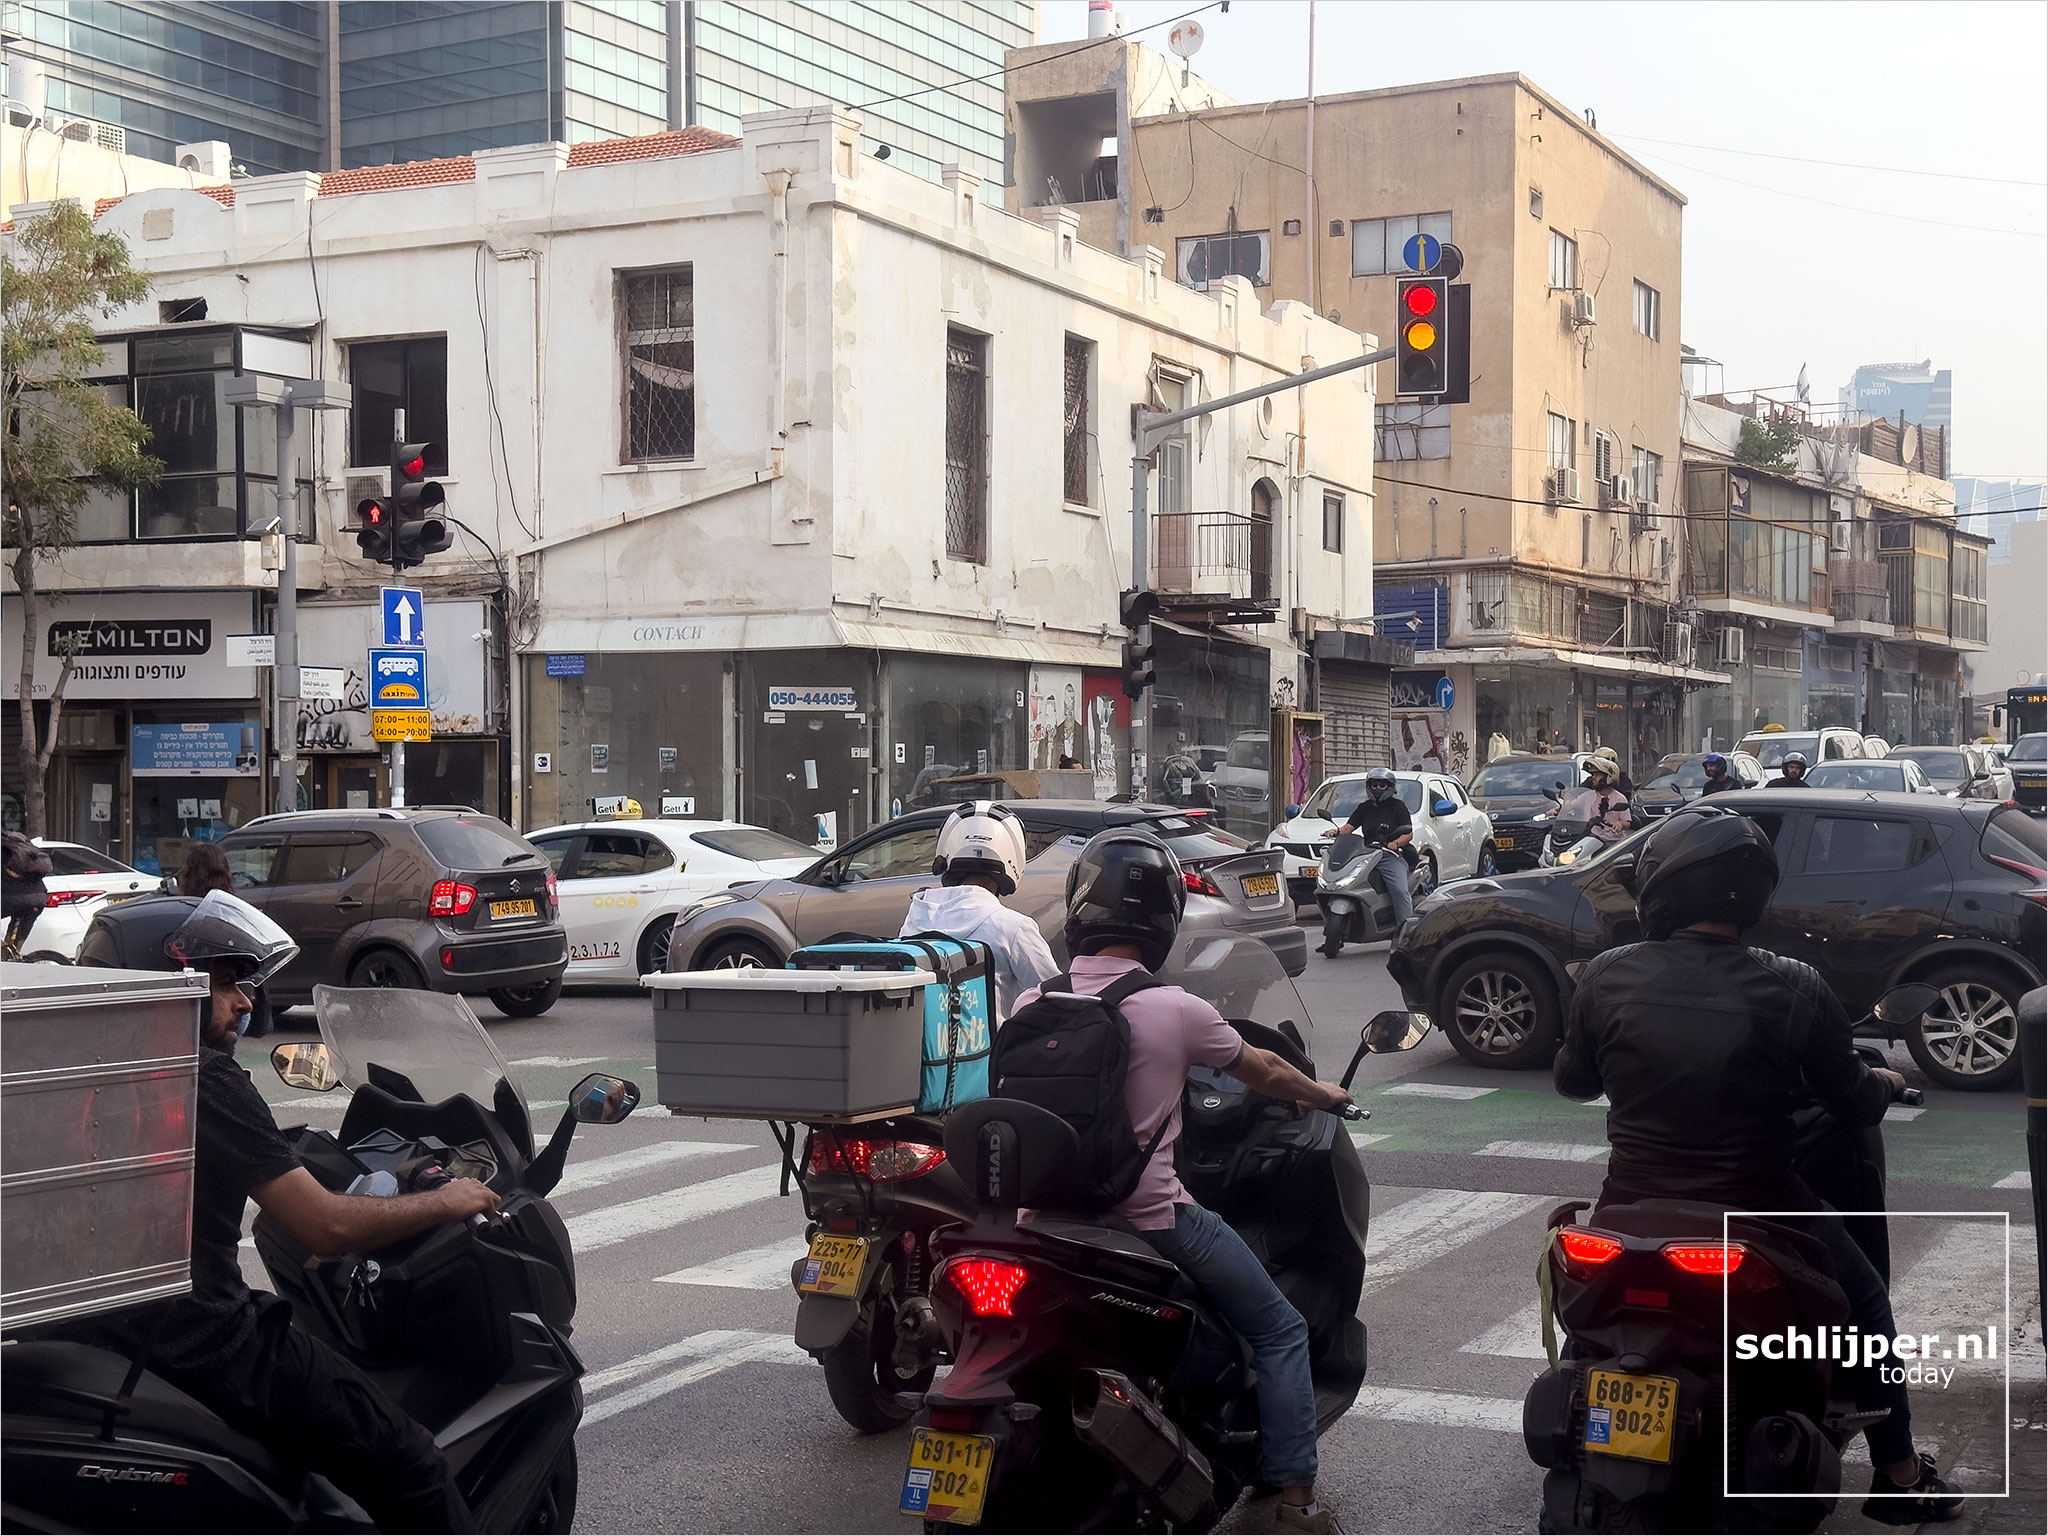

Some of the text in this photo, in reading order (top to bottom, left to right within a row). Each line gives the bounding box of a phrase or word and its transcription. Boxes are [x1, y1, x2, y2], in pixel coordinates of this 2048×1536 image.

[73, 665, 186, 681] עודפים ותצוגות
[598, 805, 615, 814] Gett
[663, 805, 681, 813] Gett
[989, 1134, 1000, 1197] SHAD
[814, 1241, 863, 1260] 225-77
[823, 1261, 846, 1279] 904
[1596, 1379, 1670, 1410] 688-75
[1615, 1409, 1653, 1436] 902
[921, 1439, 984, 1468] 691-11
[932, 1470, 968, 1496] 502
[912, 1488, 921, 1499] IL
